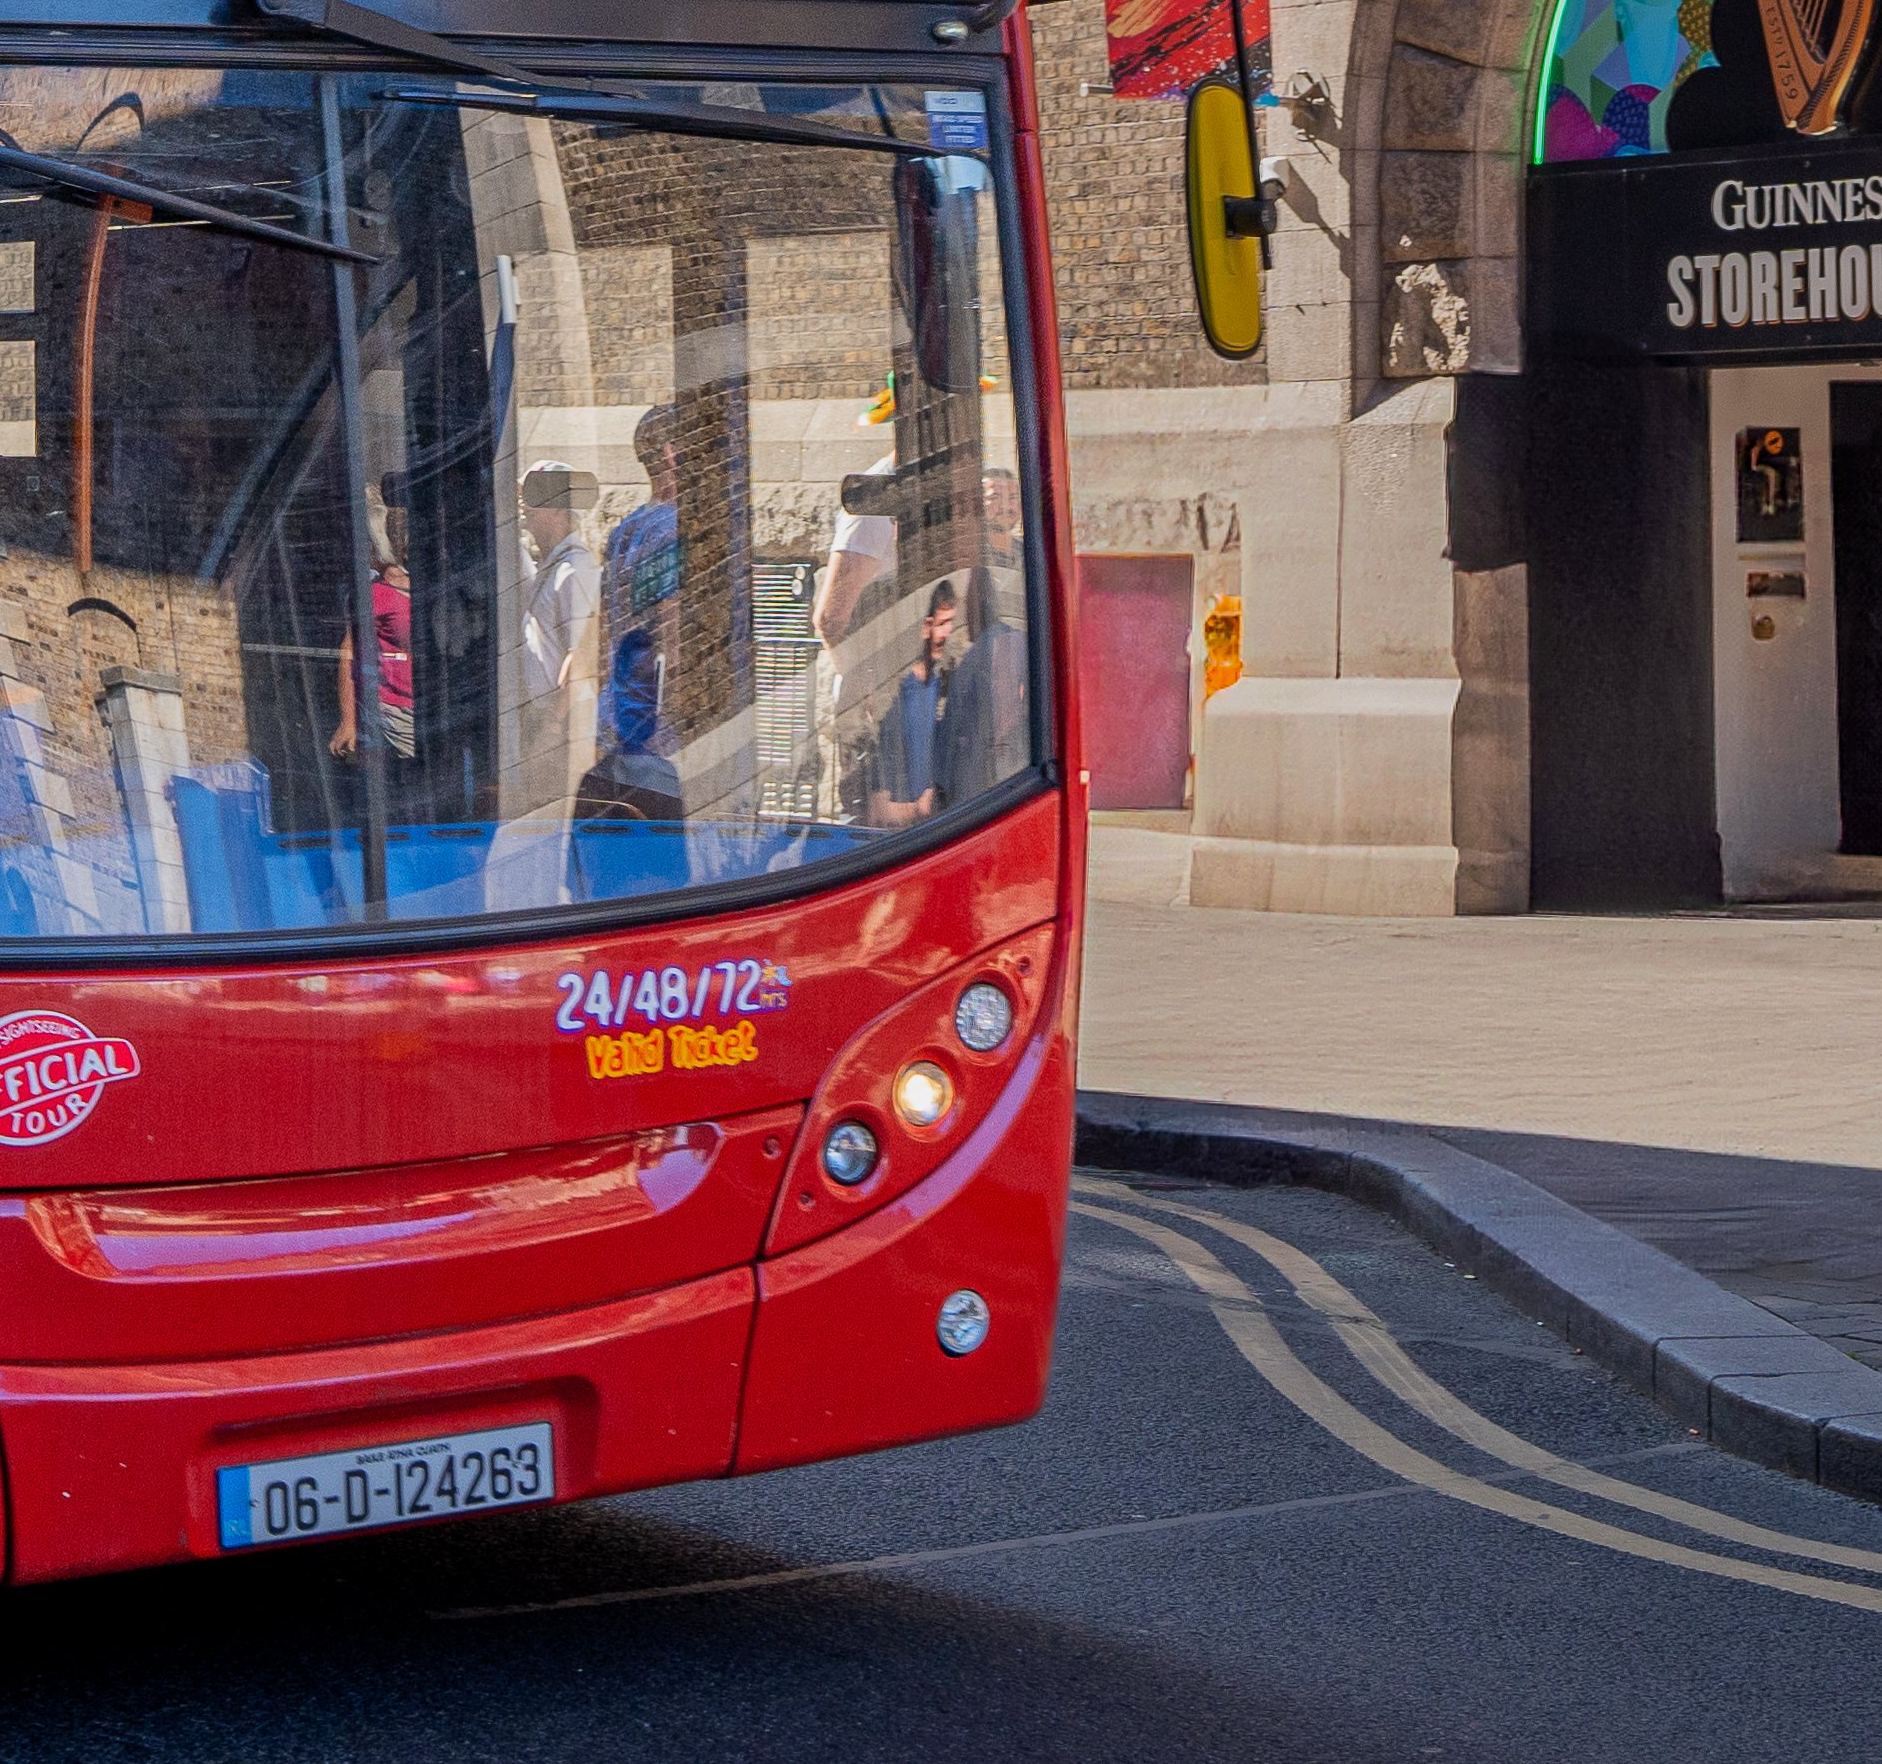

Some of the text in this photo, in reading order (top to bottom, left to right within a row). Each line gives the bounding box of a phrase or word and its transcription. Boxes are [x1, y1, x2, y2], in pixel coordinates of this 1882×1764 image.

[1775, 51, 1800, 100] 1759
[554, 956, 762, 1033] 24/48/72
[585, 1019, 759, 1080] Valid Ticket
[10, 1093, 89, 1135] TOUR
[265, 1441, 540, 1536] 06-D-124263
